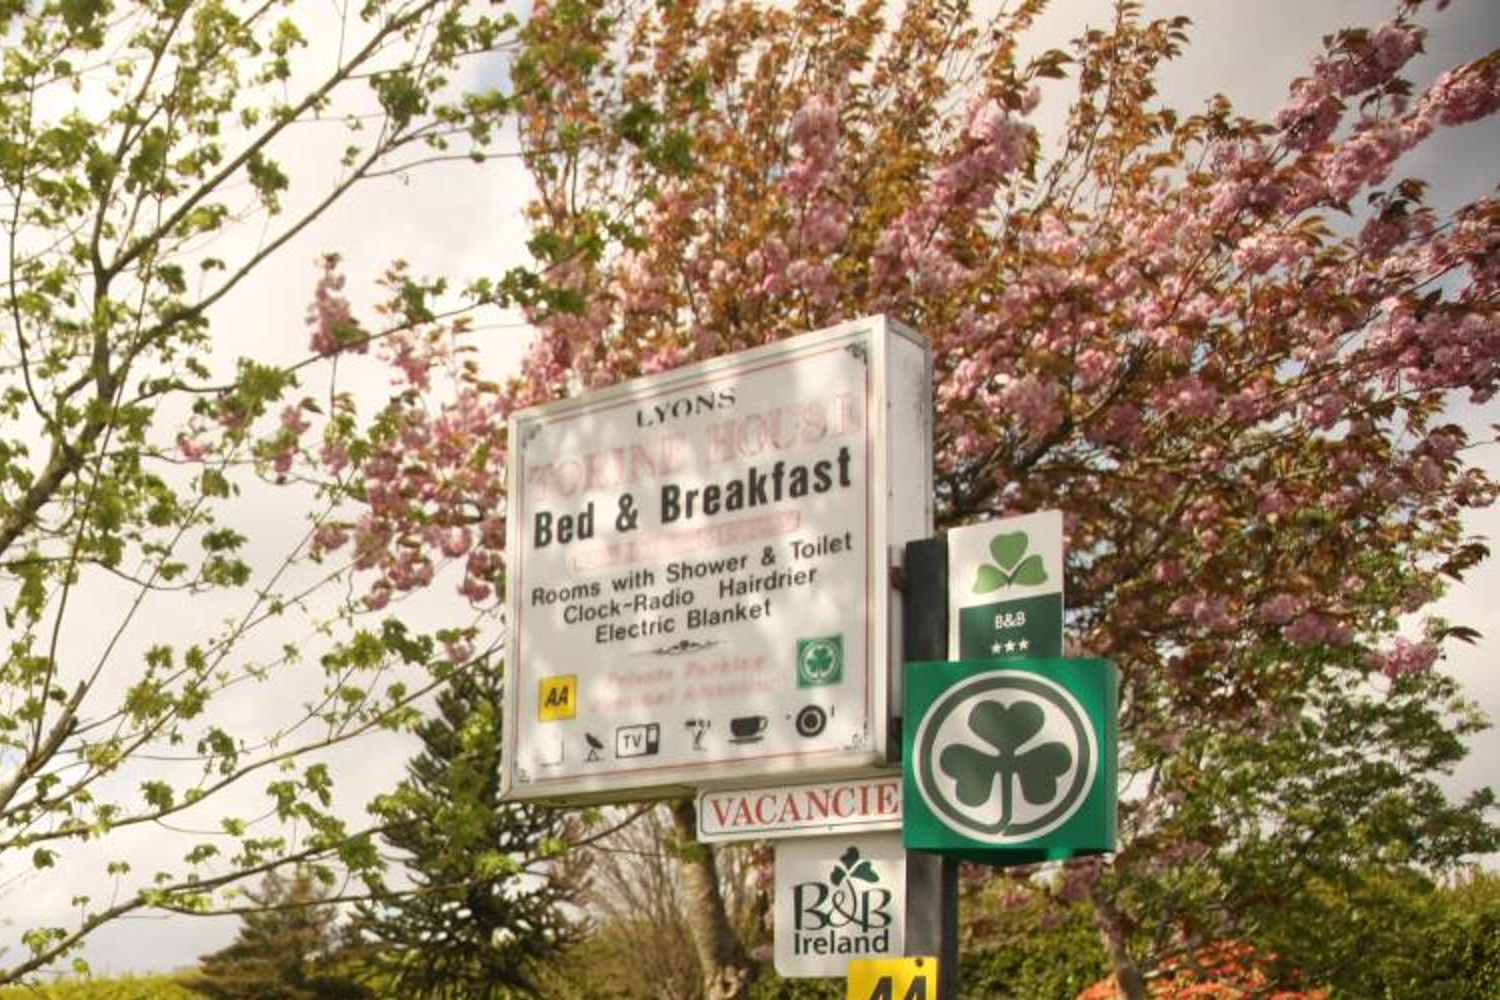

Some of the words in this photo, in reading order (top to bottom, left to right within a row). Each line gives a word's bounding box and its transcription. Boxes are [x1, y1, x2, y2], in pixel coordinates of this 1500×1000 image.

[636, 388, 738, 428] LYONS
[534, 502, 595, 549] Bed
[615, 493, 638, 532] &
[660, 446, 852, 524] Breakfast
[531, 584, 601, 607] Rooms
[612, 570, 656, 594] with
[666, 555, 749, 581] Shower
[761, 546, 777, 566] &
[789, 530, 853, 559] Toilet
[719, 567, 817, 600] Hairdrier
[595, 616, 676, 645] Electric
[687, 599, 772, 629] Blanket
[995, 611, 1026, 630] B&B
[544, 685, 570, 708] AA
[622, 733, 643, 750] TV
[711, 783, 900, 828] VACANCIE
[794, 880, 893, 933] B&B
[794, 929, 890, 956] Ireland
